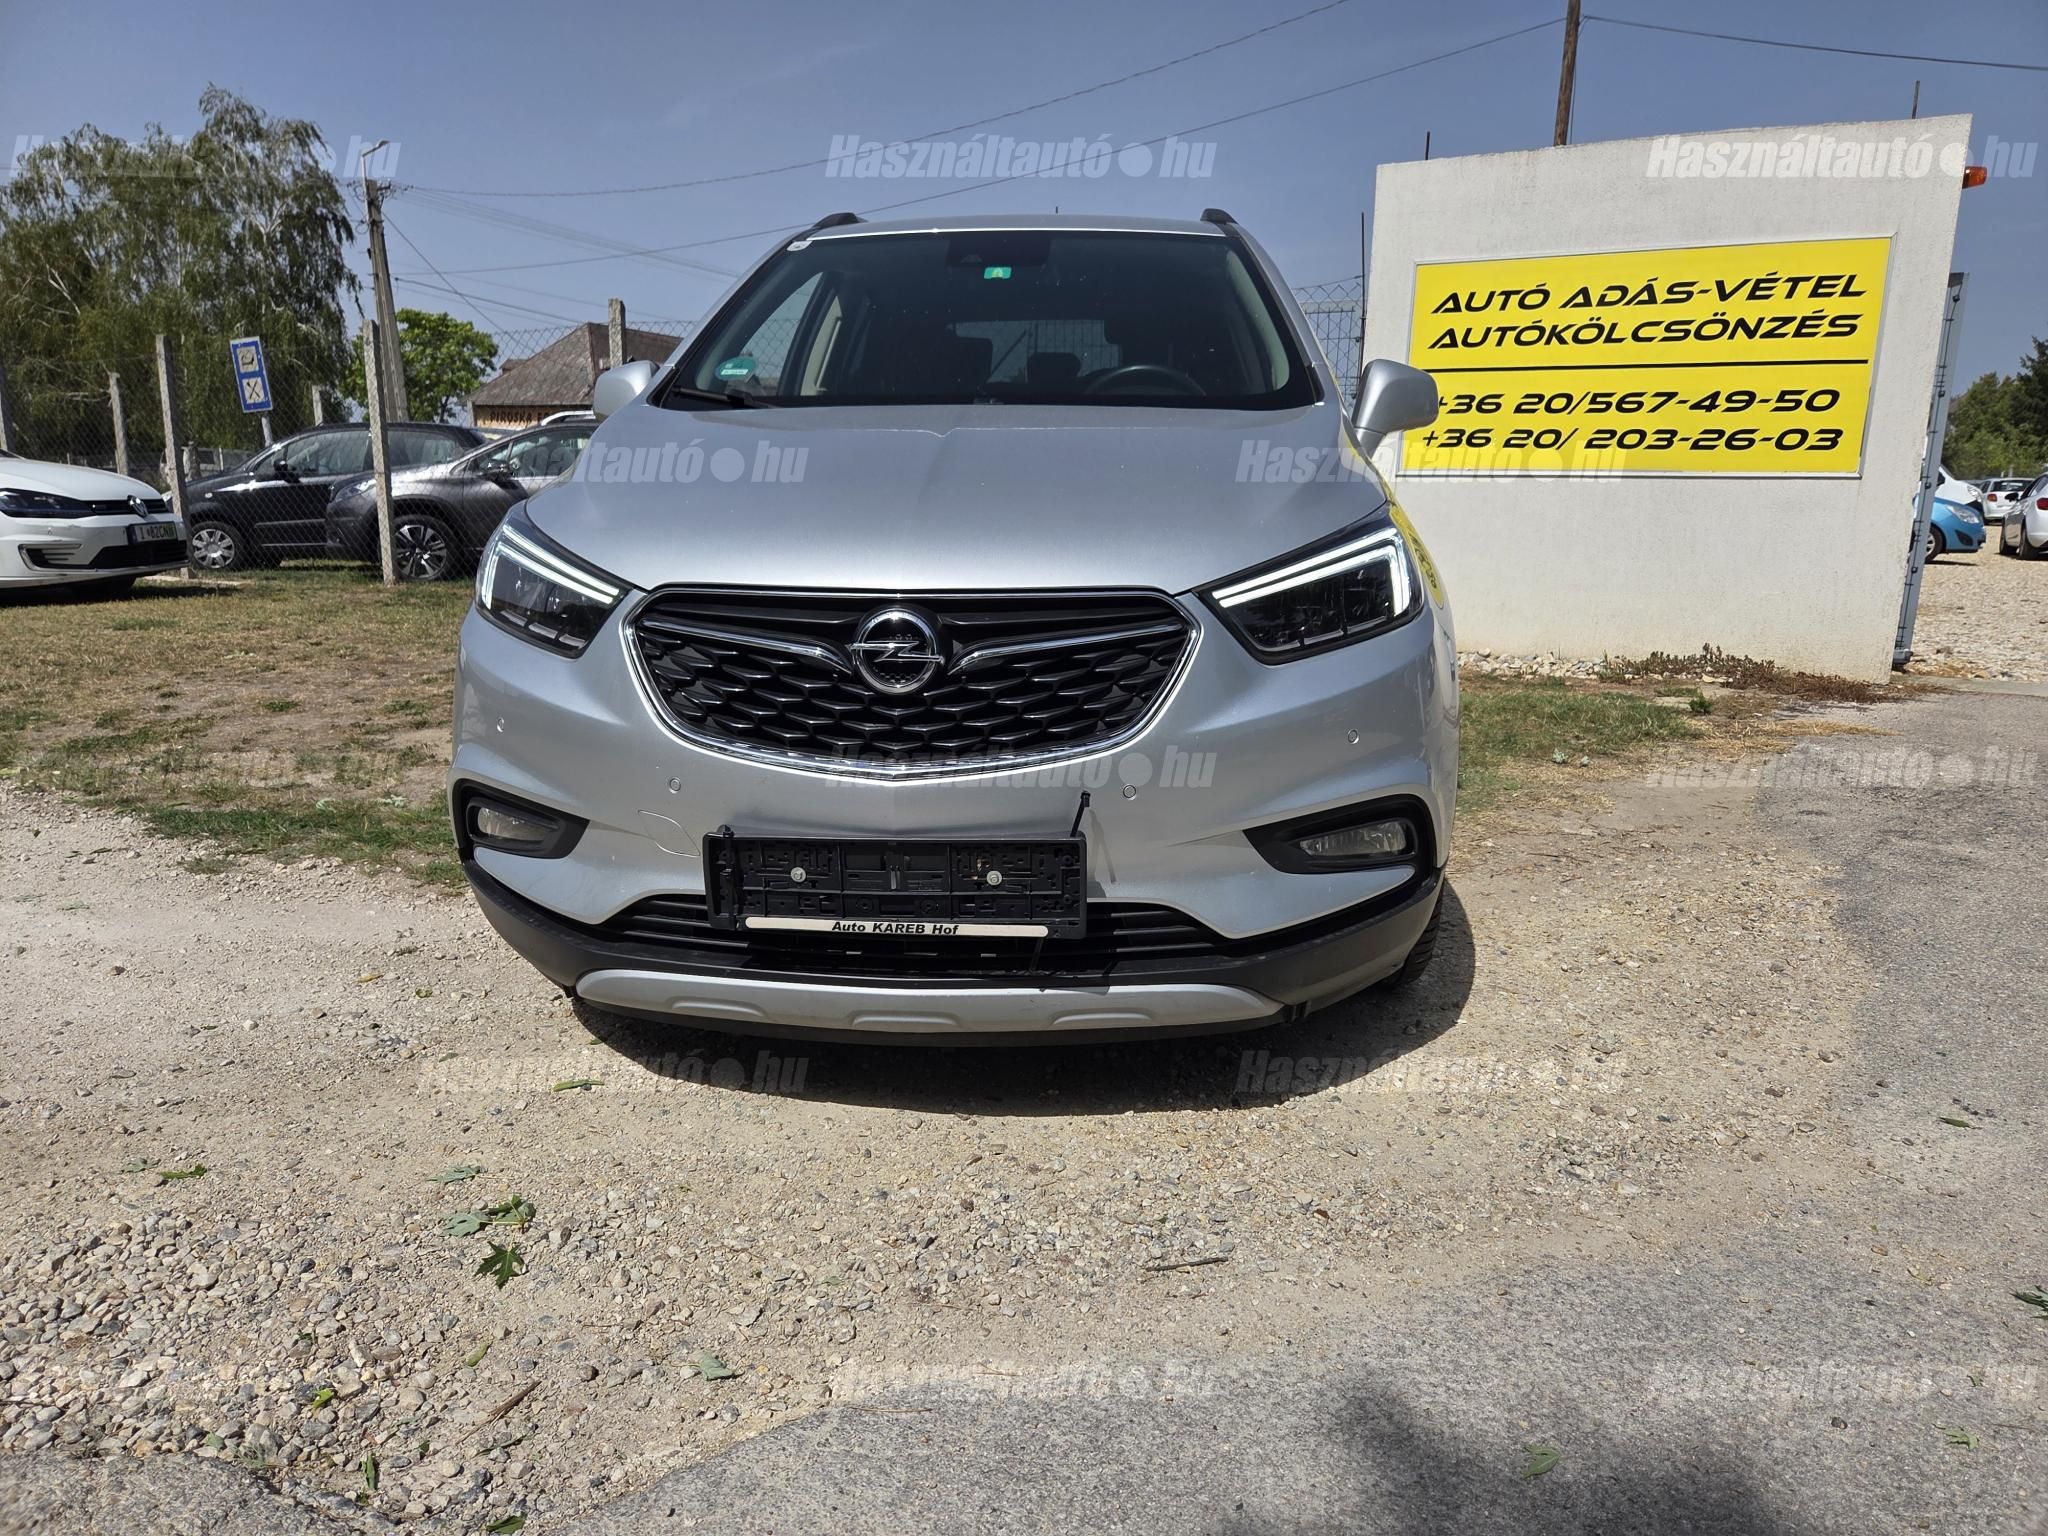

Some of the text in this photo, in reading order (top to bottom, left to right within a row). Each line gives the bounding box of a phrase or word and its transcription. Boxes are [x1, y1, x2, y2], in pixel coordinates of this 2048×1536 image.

[1431, 271, 1867, 314] AUTÓ ADÁS-VÉTEL
[1427, 308, 1864, 350] AUTÓKÖLCSÖNZÉS
[1512, 389, 1840, 415] 20/567-49-50
[1422, 427, 1844, 451] +36 20/ 203-26-03
[832, 921, 959, 935] Auto KAREB Hof
